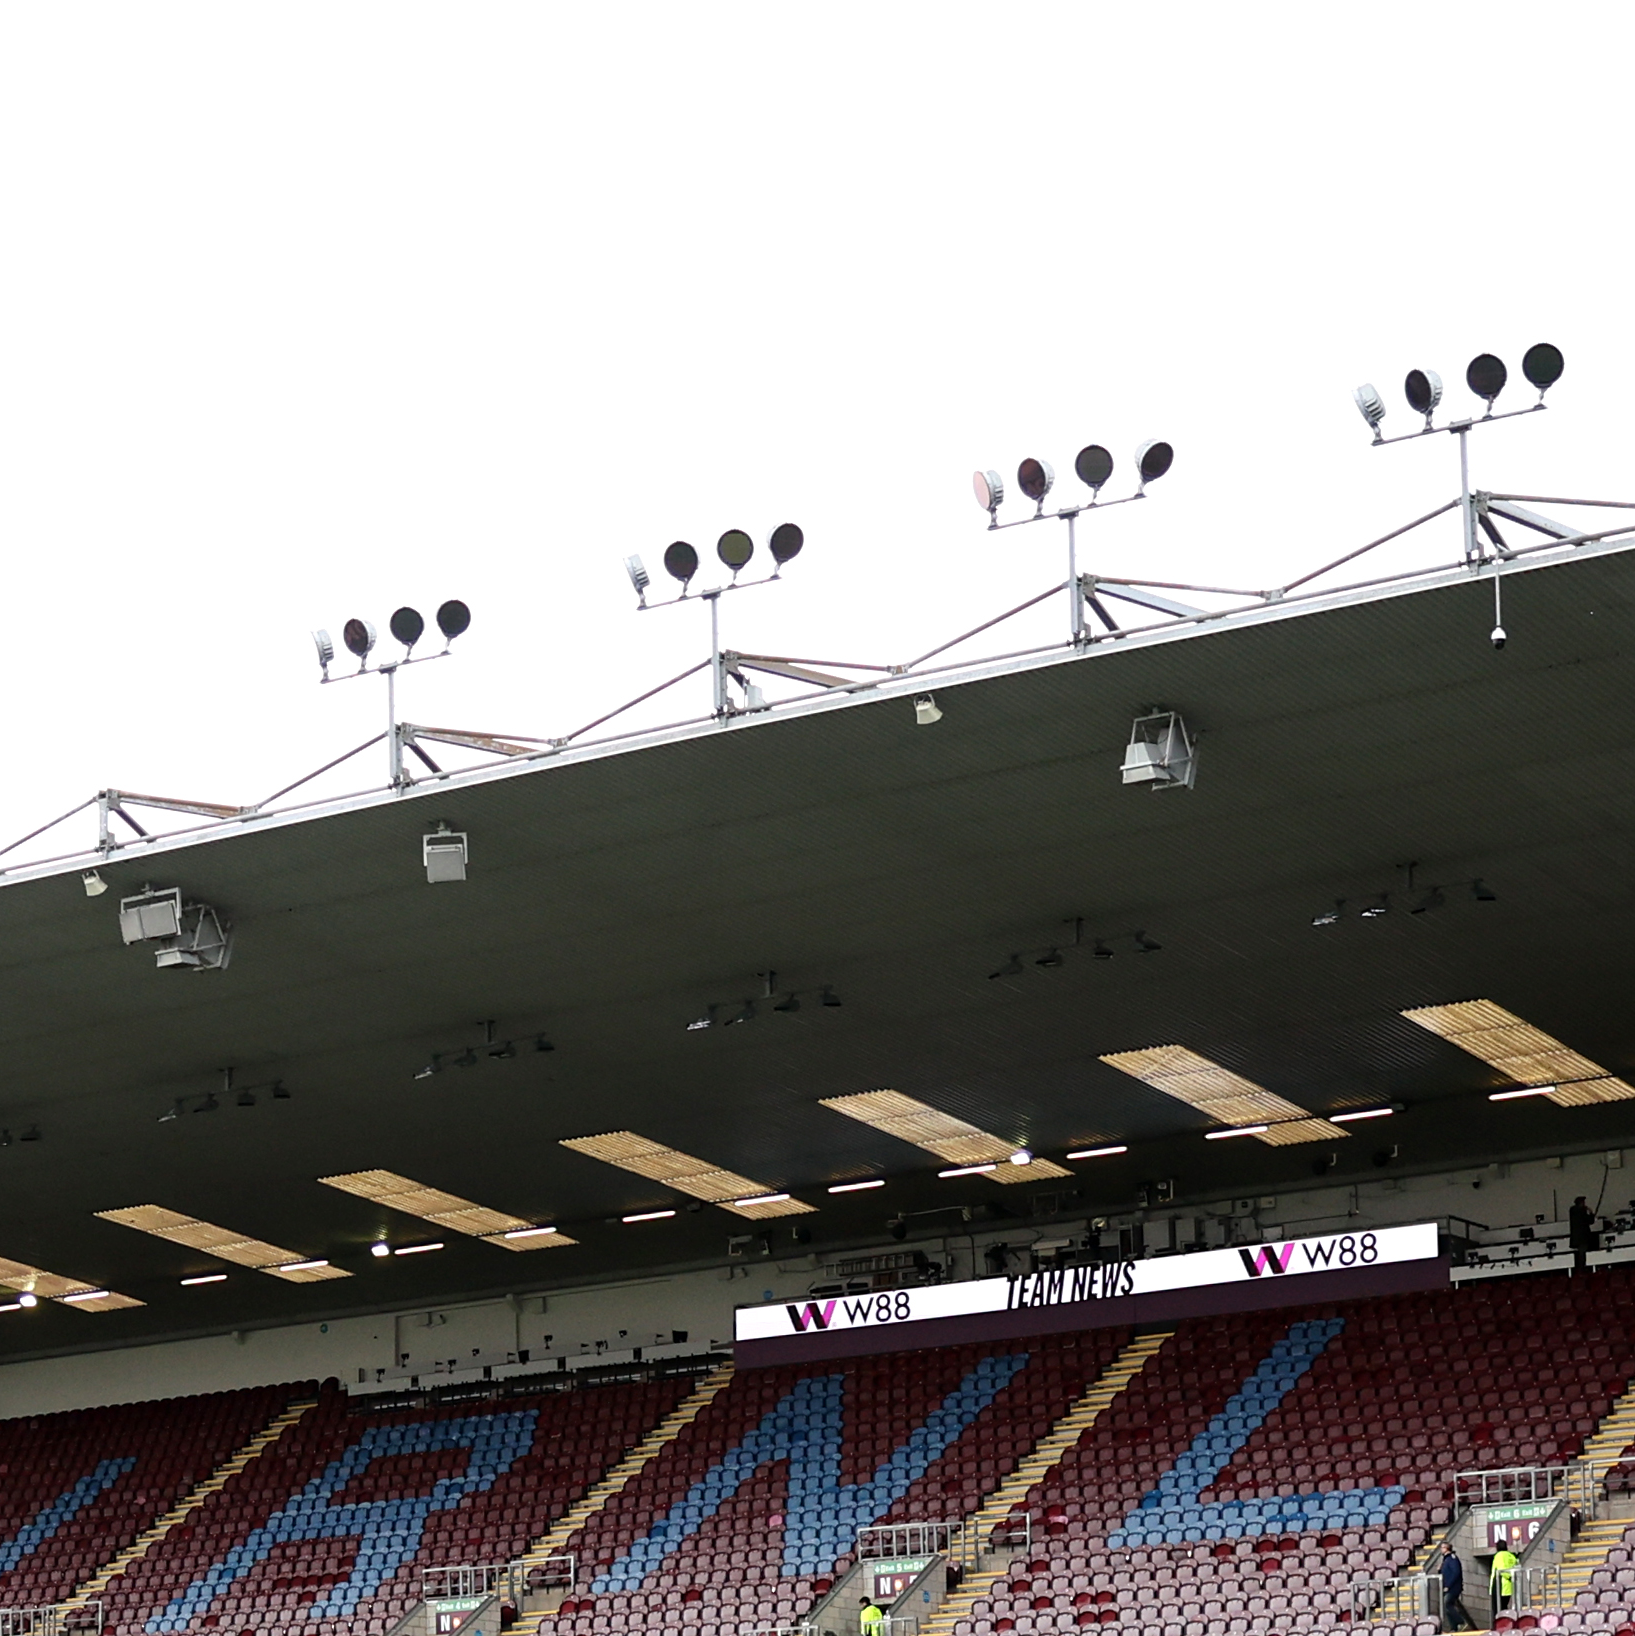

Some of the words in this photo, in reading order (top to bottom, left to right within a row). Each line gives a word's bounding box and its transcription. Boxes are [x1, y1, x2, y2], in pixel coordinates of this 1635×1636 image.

[1302, 1233, 1378, 1269] W88
[1007, 1269, 1064, 1309] TEAM
[1072, 1261, 1135, 1303] NEWS
[843, 1292, 910, 1325] W88
[1494, 1524, 1507, 1543] N
[897, 1563, 902, 1572] 5
[880, 1577, 891, 1595] N
[440, 1614, 450, 1632] N
